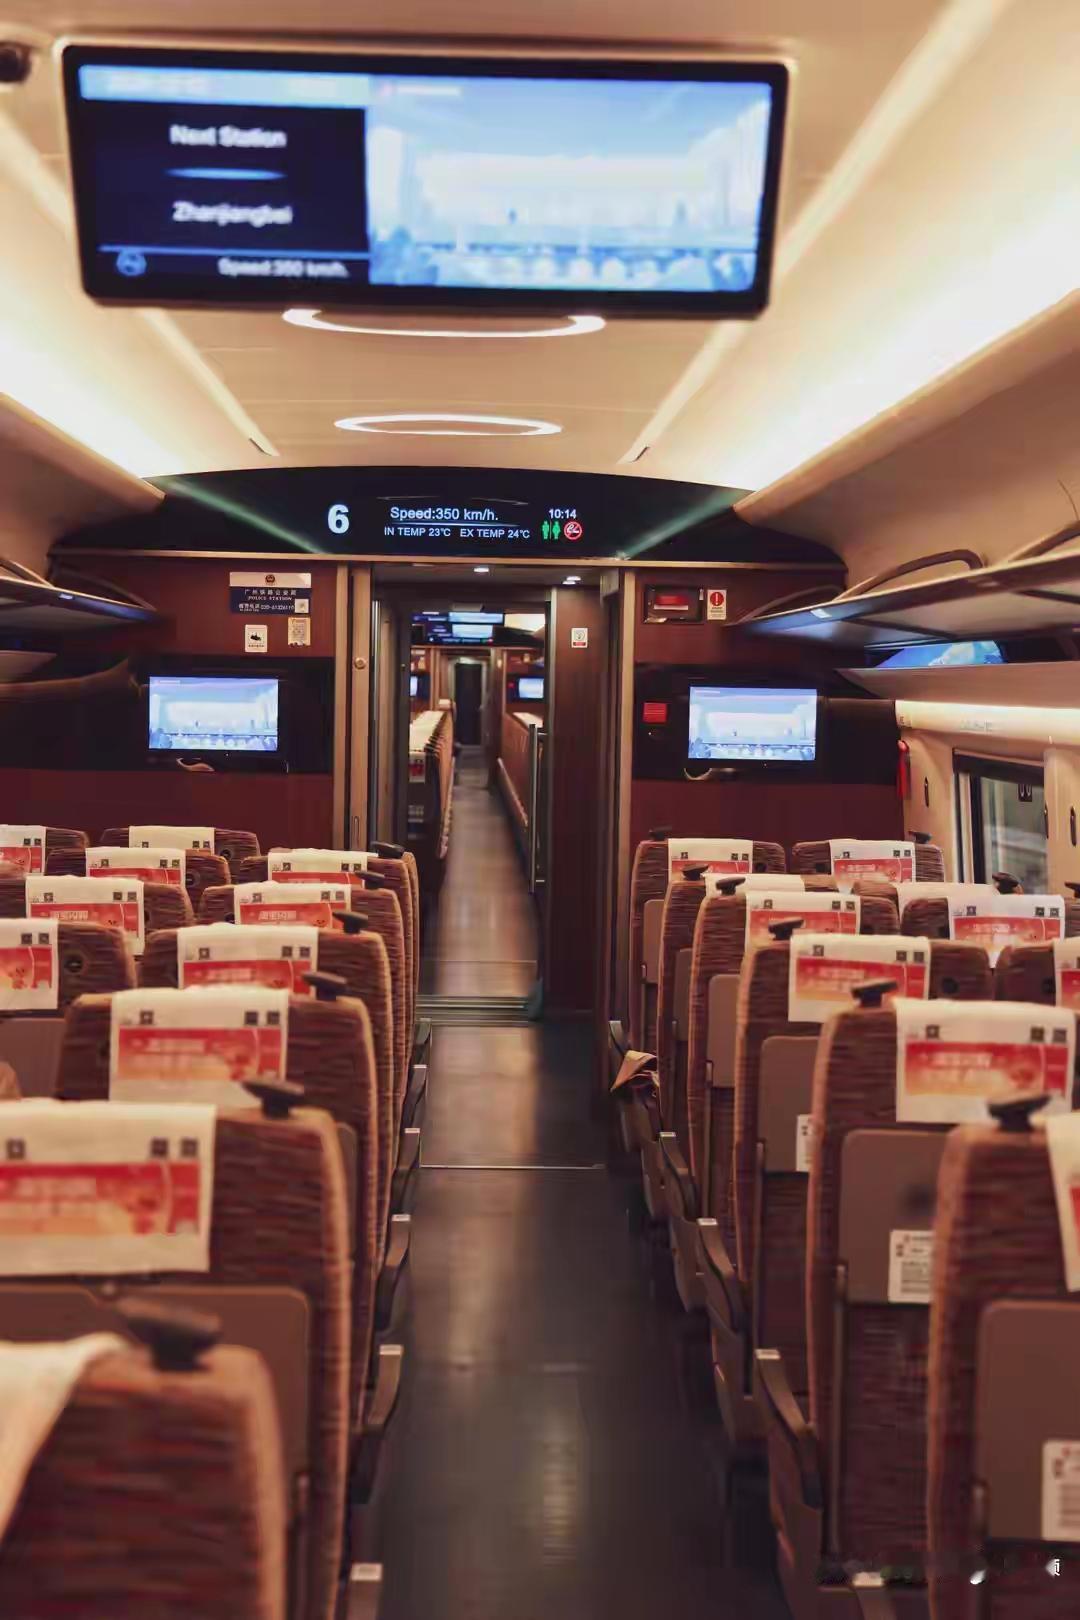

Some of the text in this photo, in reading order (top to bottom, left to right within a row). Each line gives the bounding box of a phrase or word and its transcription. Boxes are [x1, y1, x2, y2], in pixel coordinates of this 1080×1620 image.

[170, 124, 287, 148] Next Station
[327, 504, 350, 534] 6
[390, 506, 460, 521] Speed:350
[548, 509, 577, 519] 10:14
[384, 526, 395, 536] IN
[397, 527, 426, 536] TEMP
[460, 528, 474, 537] EX
[476, 529, 505, 538] TEMP
